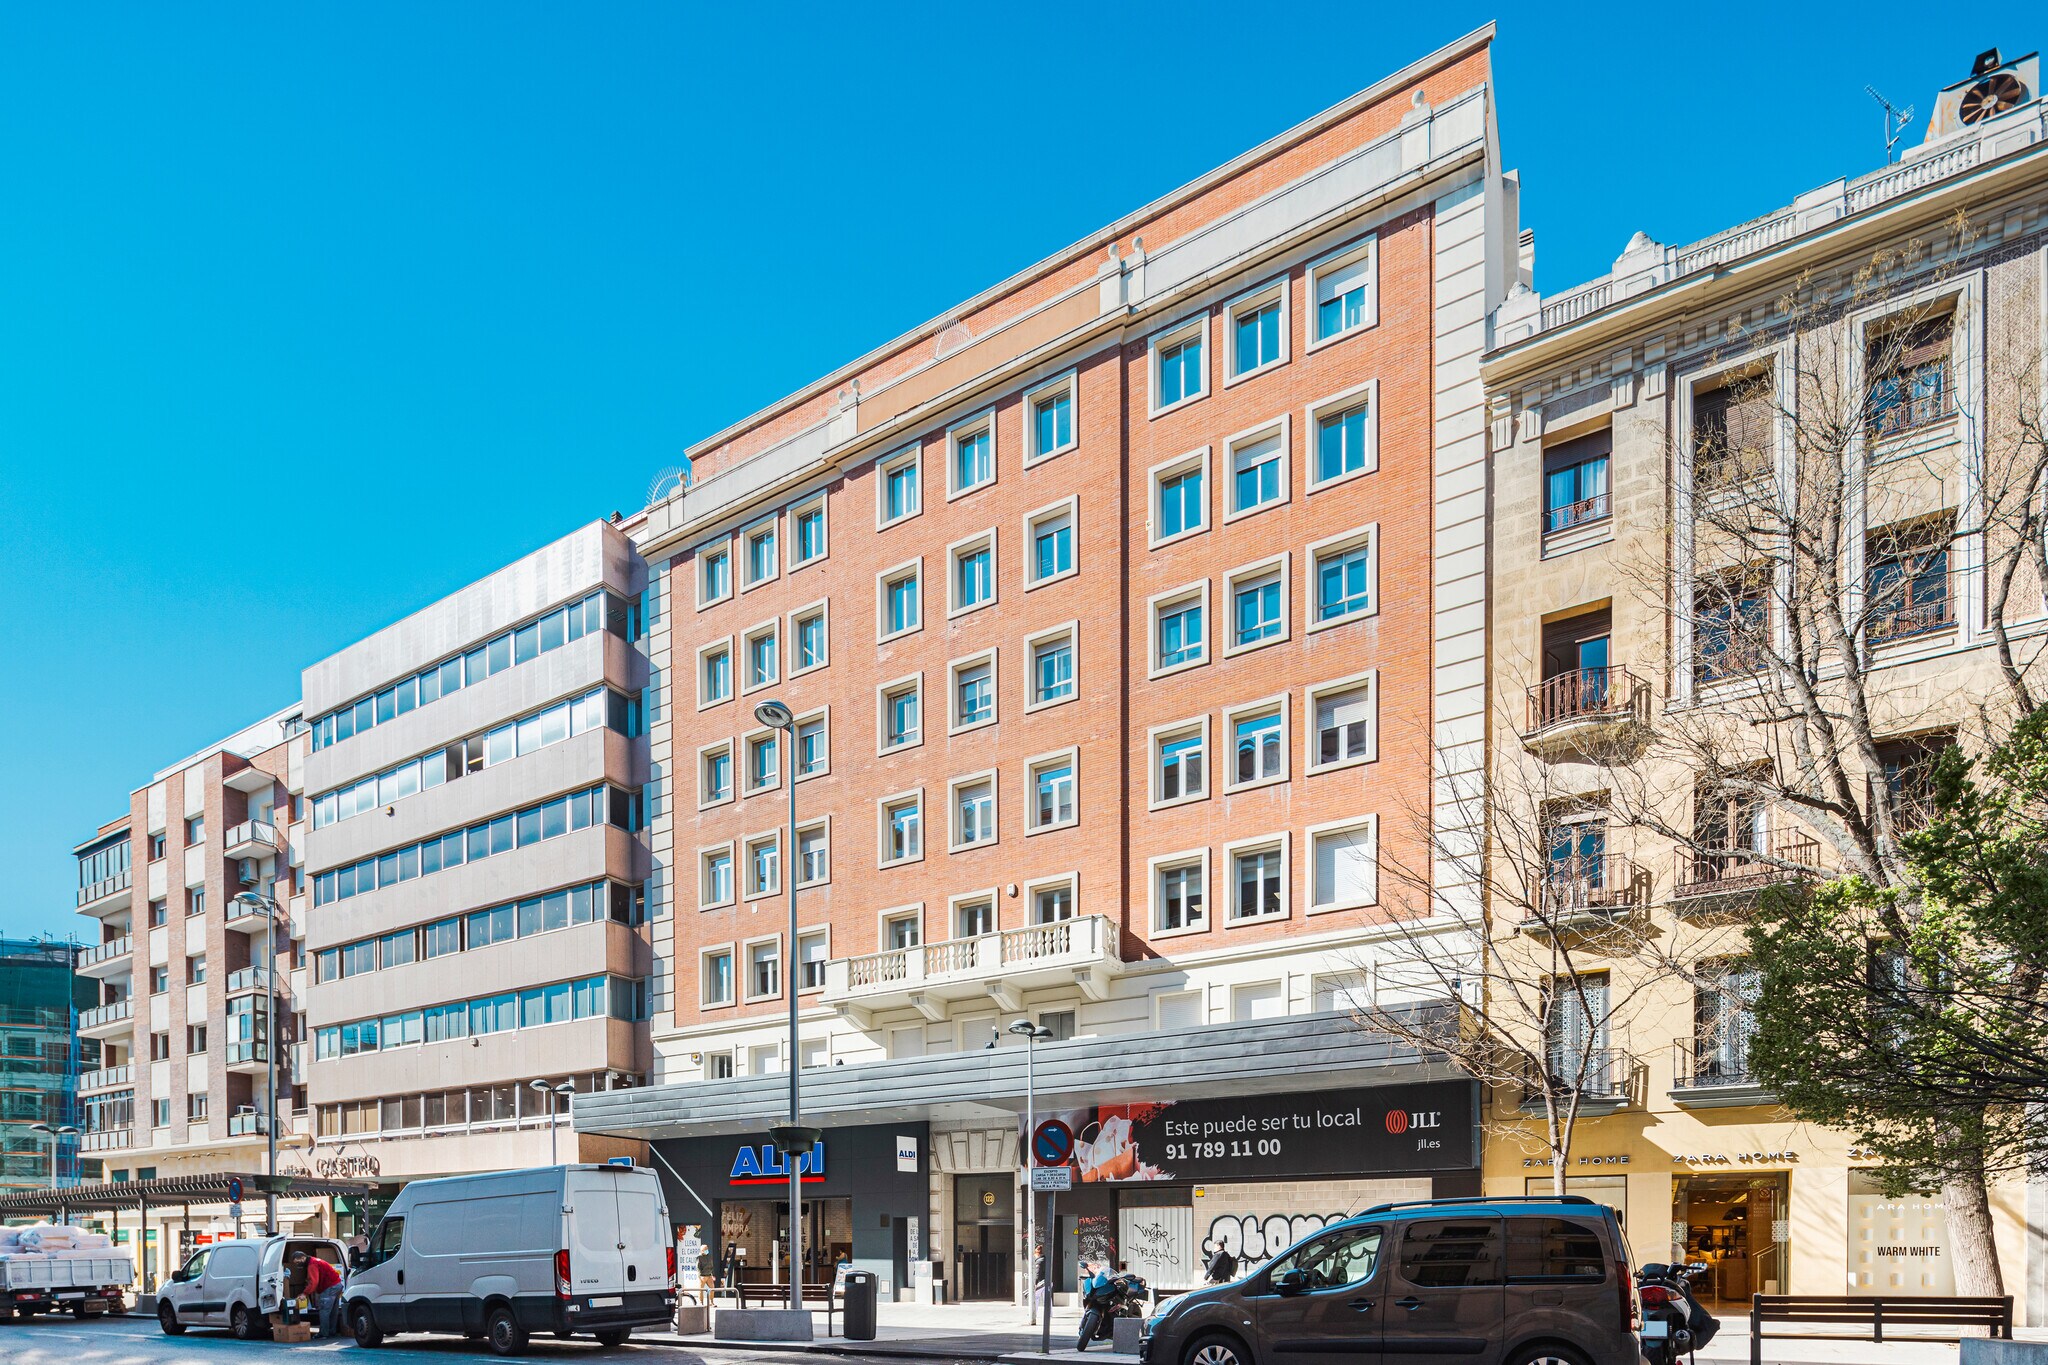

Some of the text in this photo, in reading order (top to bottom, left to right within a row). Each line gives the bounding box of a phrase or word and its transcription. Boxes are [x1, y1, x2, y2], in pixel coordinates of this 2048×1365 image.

[1165, 1107, 1362, 1138] Este puede ser tu local
[1166, 1138, 1282, 1160] 91 789 11 00
[1416, 1138, 1441, 1151] jll.es
[899, 1149, 916, 1159] ALDI
[1673, 1151, 1794, 1163] ZARA HOME
[1846, 1148, 1875, 1157] ZA
[1523, 1156, 1629, 1168] ZAR HOME
[721, 1211, 744, 1221] FELIZ
[721, 1223, 749, 1233] OMPRA
[1877, 1246, 1941, 1257] WARM WHITE
